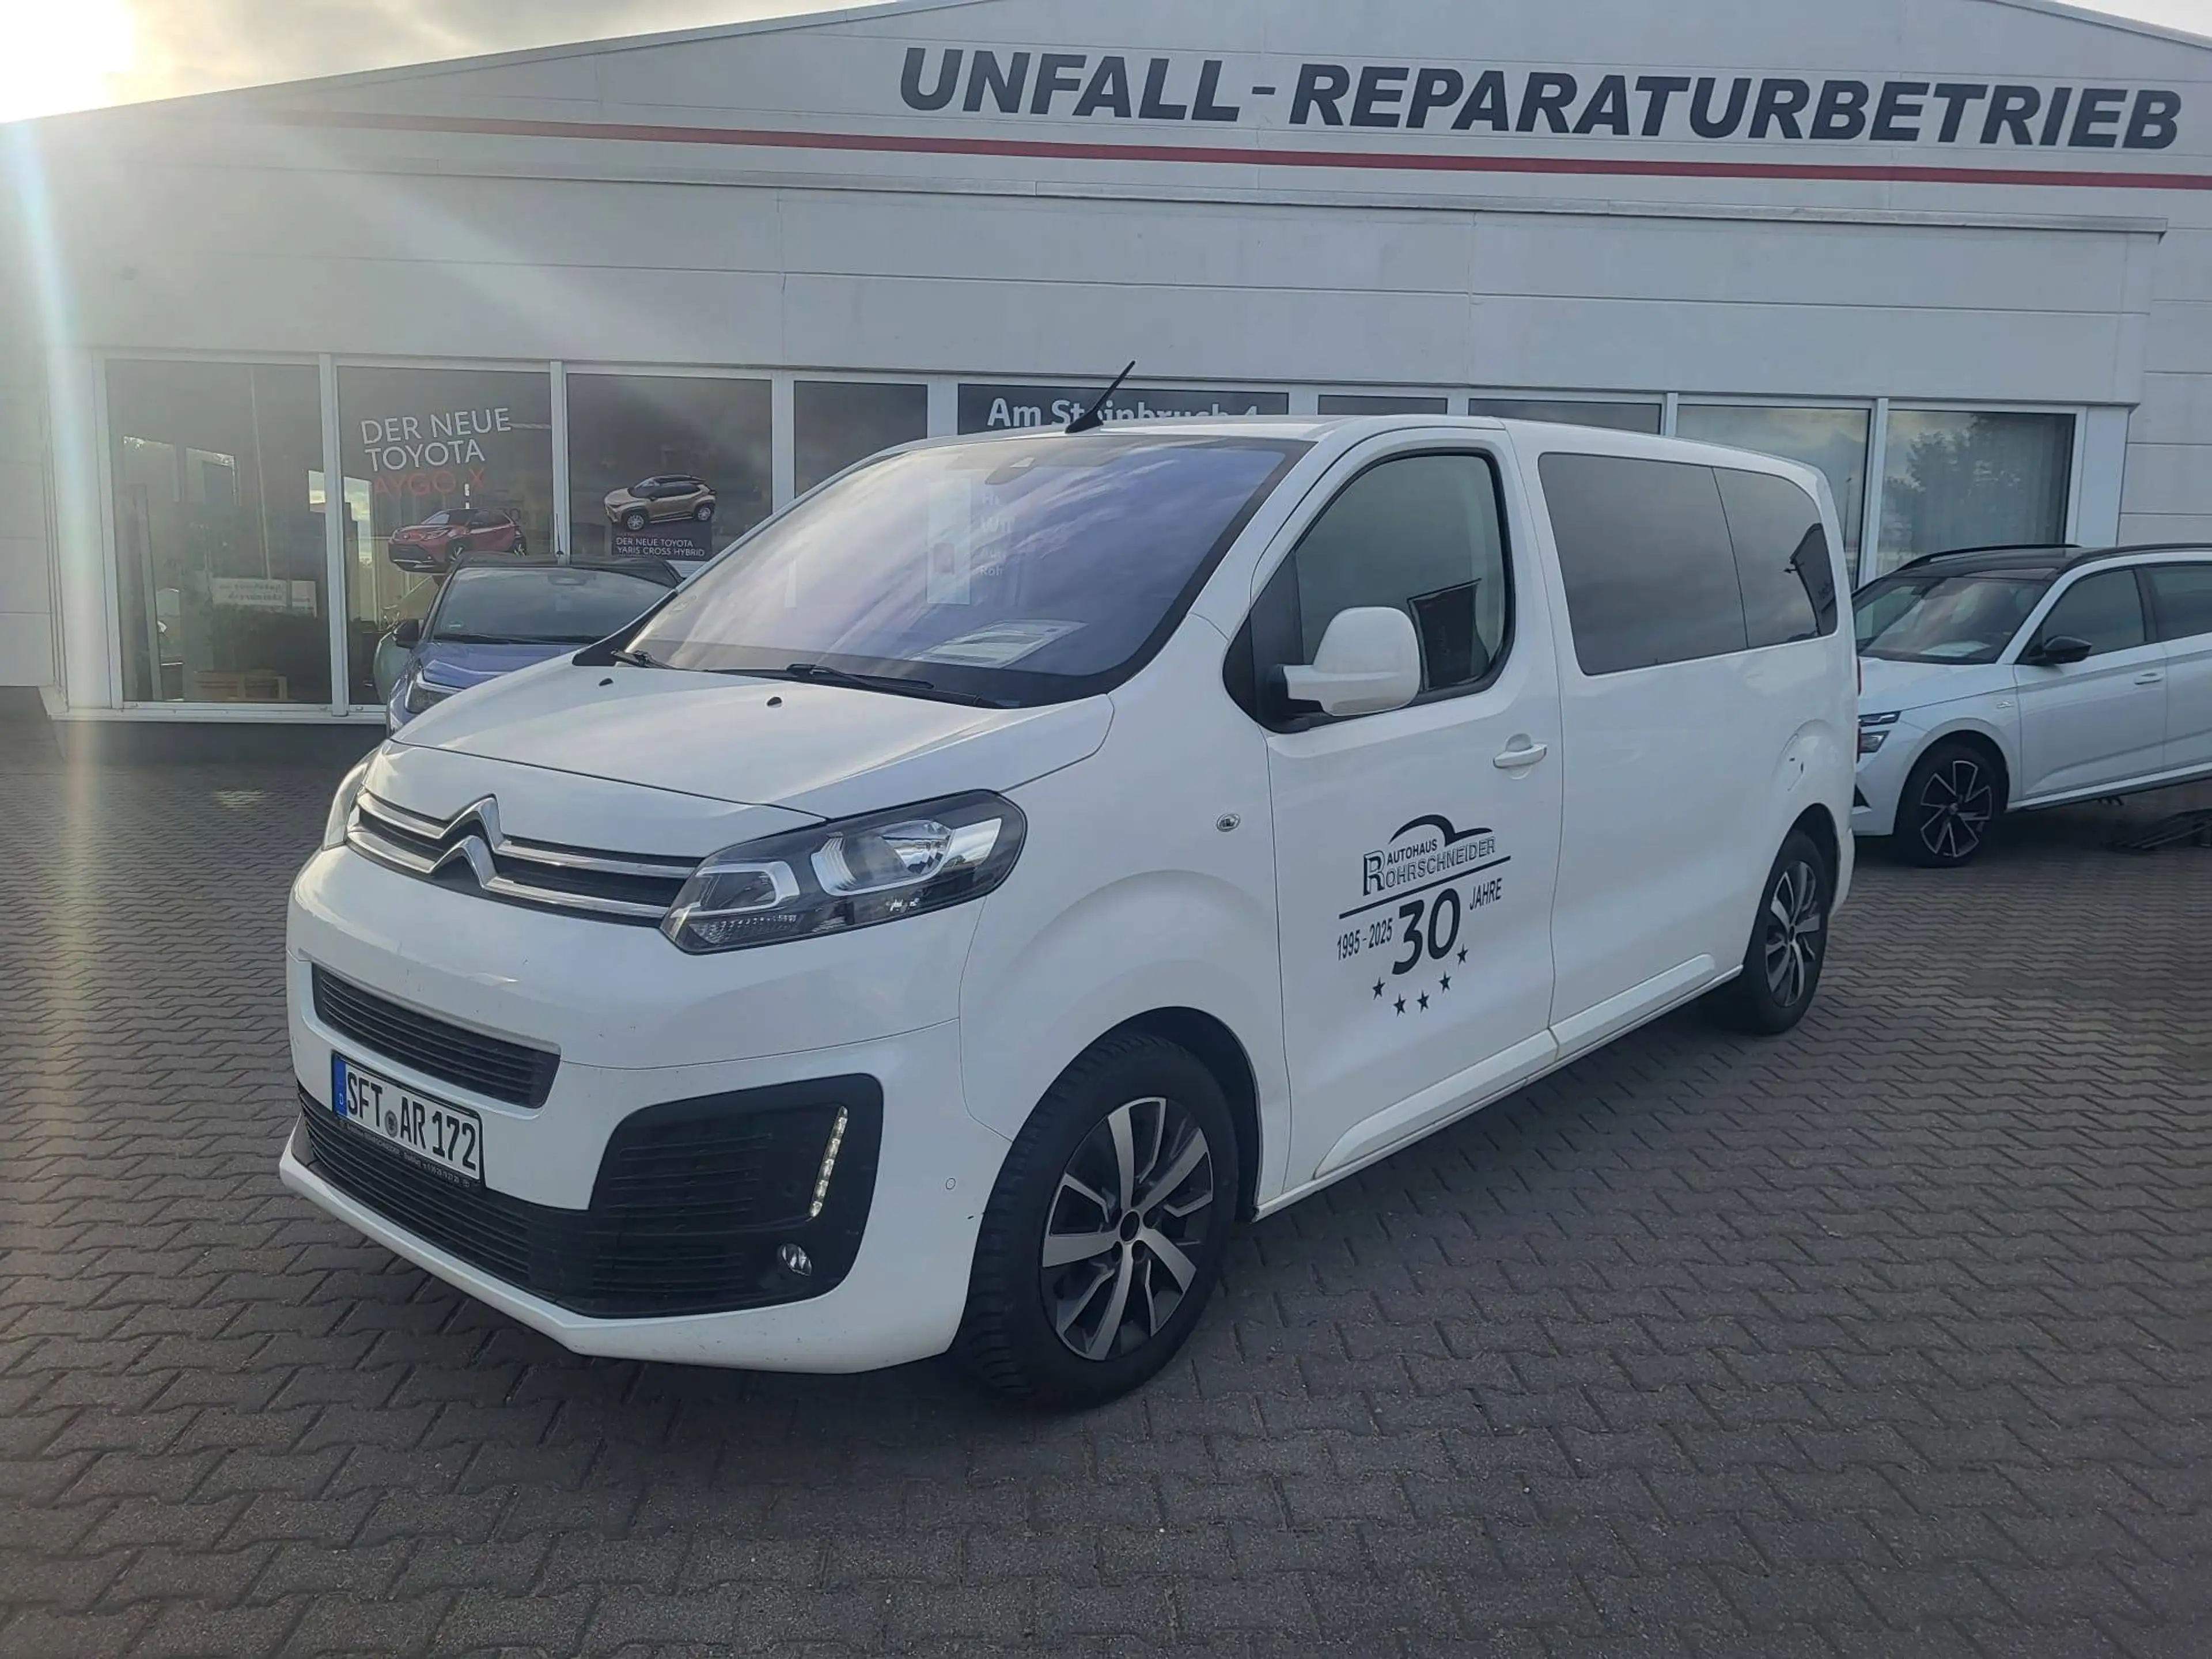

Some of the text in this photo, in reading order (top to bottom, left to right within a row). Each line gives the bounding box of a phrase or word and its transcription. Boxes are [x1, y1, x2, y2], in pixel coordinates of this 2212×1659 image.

[361, 407, 511, 445] DER NEUE
[987, 398, 1041, 427] Am
[365, 439, 486, 472] TOYOTA
[375, 470, 456, 499] AYGO
[616, 536, 694, 548] DER NEUE TOYOTA
[618, 547, 706, 556] YARIS CROSS HYBRID
[1363, 836, 1496, 897] ROHRSCHNEIDER
[1386, 839, 1438, 866] AUTOHAUS
[1337, 929, 1361, 961] 1995
[1368, 917, 1393, 949] 2025
[1392, 888, 1461, 976] 30
[1469, 877, 1503, 911] JAHRE
[347, 1071, 383, 1127] SFT
[400, 1094, 426, 1150] AR
[432, 1109, 477, 1172] 172
